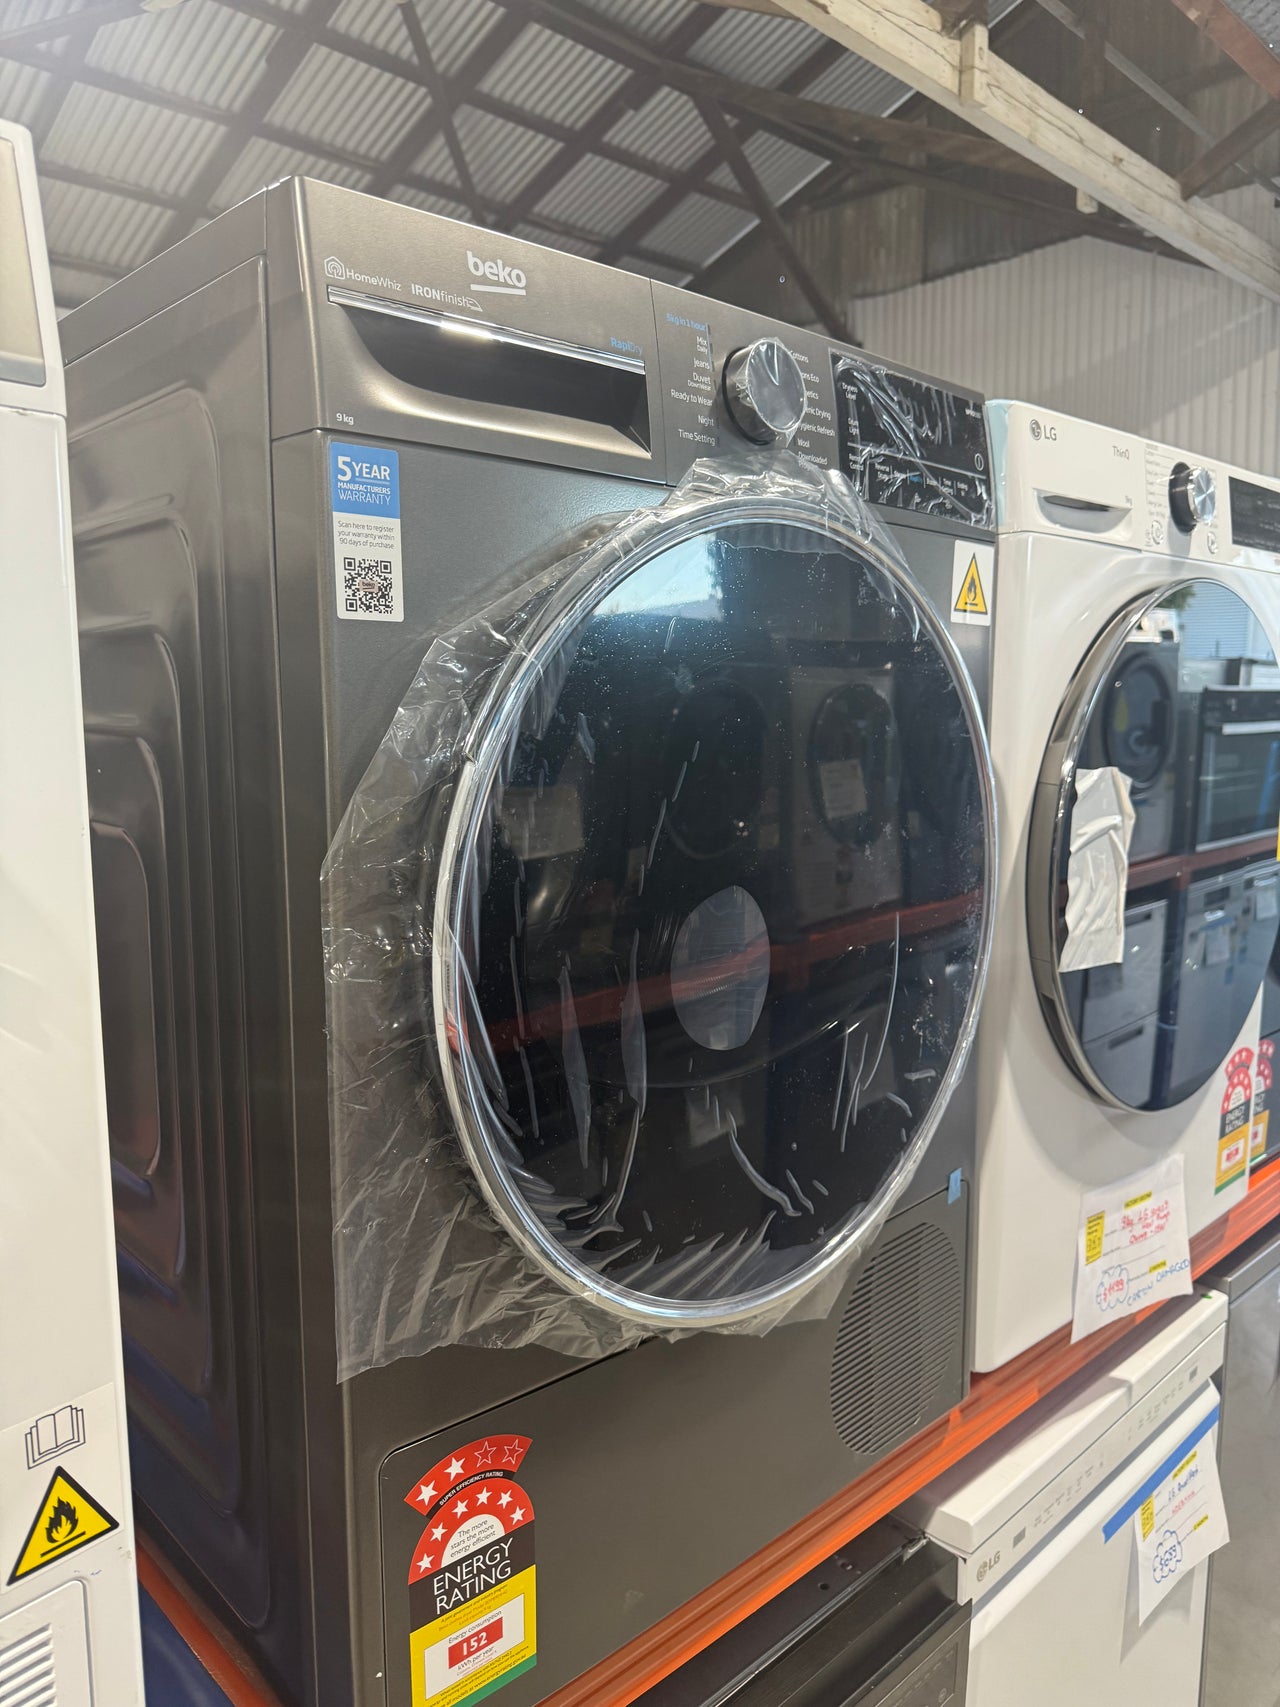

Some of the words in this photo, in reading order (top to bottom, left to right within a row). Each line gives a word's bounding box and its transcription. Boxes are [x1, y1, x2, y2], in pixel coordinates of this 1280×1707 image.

[467, 250, 527, 288] beko
[346, 268, 402, 291] HomeWhiz
[411, 283, 470, 308] IRONfinish
[693, 357, 710, 370] Jeans
[693, 371, 711, 385] Duvet
[671, 389, 690, 403] Ready
[690, 394, 697, 403] to
[697, 395, 713, 406] Wear
[336, 412, 343, 422] 9
[343, 413, 354, 425] kg
[698, 414, 714, 427] Night
[815, 408, 831, 421] Drying
[678, 428, 694, 440] Time
[693, 432, 715, 447] Setting
[1044, 424, 1057, 441] LG
[1112, 445, 1130, 460] ThinQ
[338, 455, 352, 481] 5
[352, 461, 391, 480] YEAR
[338, 481, 391, 495] MANUFACTURERS
[338, 489, 391, 505] WARRANTY
[338, 520, 352, 528] Scan
[352, 522, 366, 530] here
[373, 525, 395, 533] register
[339, 537, 348, 545] 90
[348, 538, 362, 548] days
[369, 541, 395, 550] purchase
[352, 532, 377, 541] warranty
[439, 1489, 456, 1506] SUPER
[456, 1473, 485, 1492] EFFICIENCY
[450, 1539, 466, 1550] stars
[466, 1533, 477, 1541] the
[477, 1524, 494, 1535] more
[458, 1528, 471, 1537] The
[471, 1520, 488, 1532] more
[450, 1544, 471, 1558] energy
[472, 1530, 496, 1546] efficient
[433, 1537, 514, 1596] ENERGY
[989, 1551, 1001, 1571] LG
[436, 1560, 511, 1615] RATING
[448, 1629, 467, 1644] Energy
[468, 1610, 502, 1633] consumption
[462, 1631, 488, 1656] 152
[457, 1659, 472, 1670] kWh
[472, 1653, 482, 1662] per
[482, 1646, 495, 1657] year
